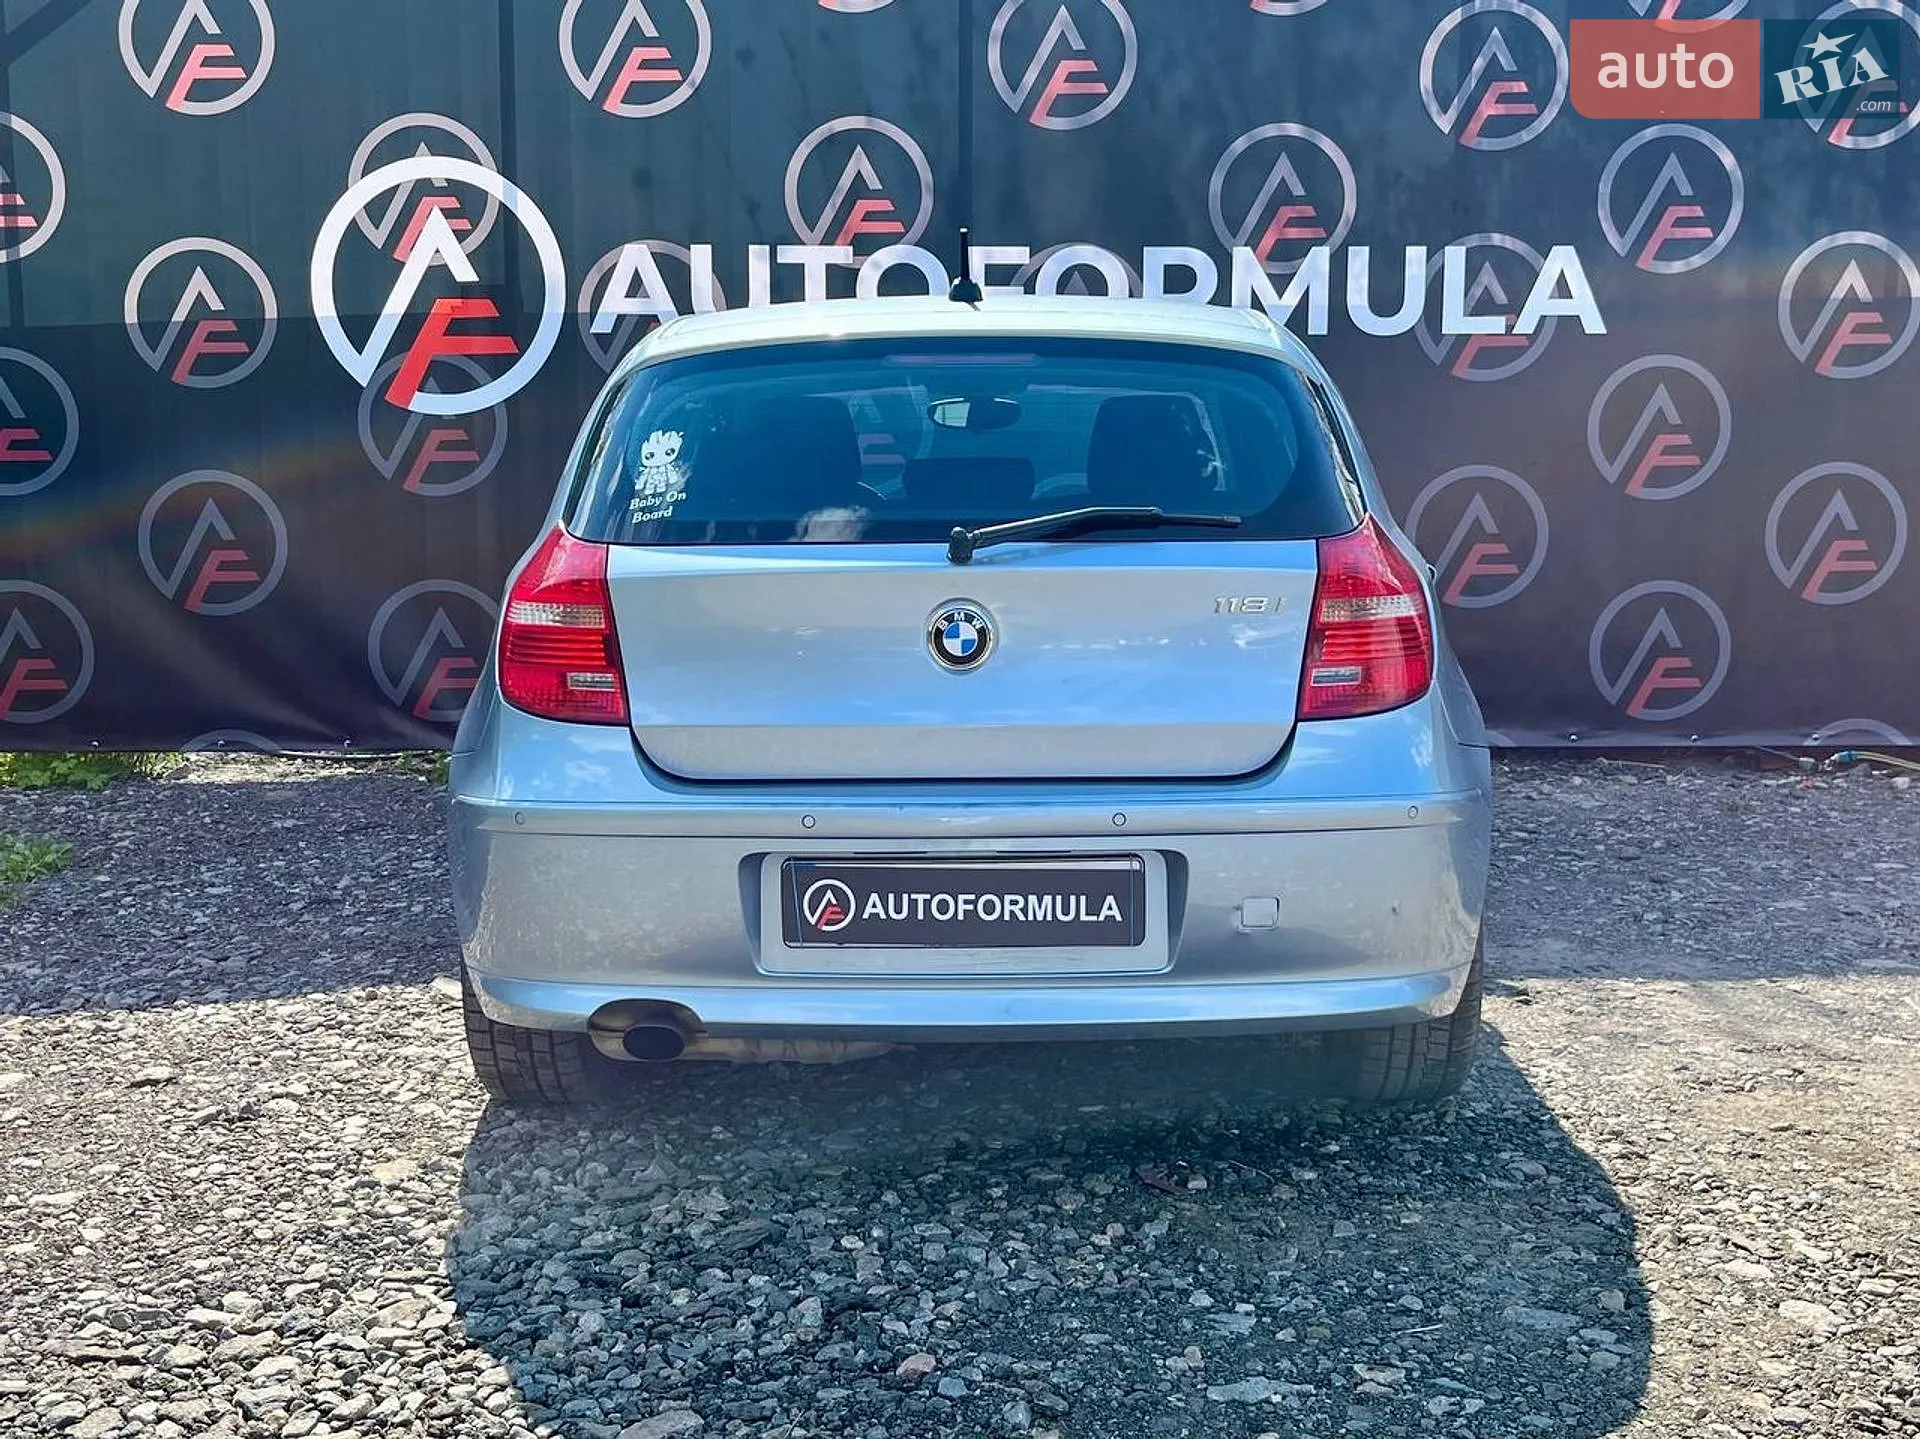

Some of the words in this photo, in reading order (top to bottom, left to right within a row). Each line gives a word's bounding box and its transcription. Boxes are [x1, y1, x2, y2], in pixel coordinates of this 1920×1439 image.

[590, 244, 1607, 335] AUTOFORMULA
[629, 495, 662, 510] Baby
[666, 490, 686, 503] On
[632, 506, 673, 523] Board
[862, 891, 1123, 922] AUTOFORMULA
